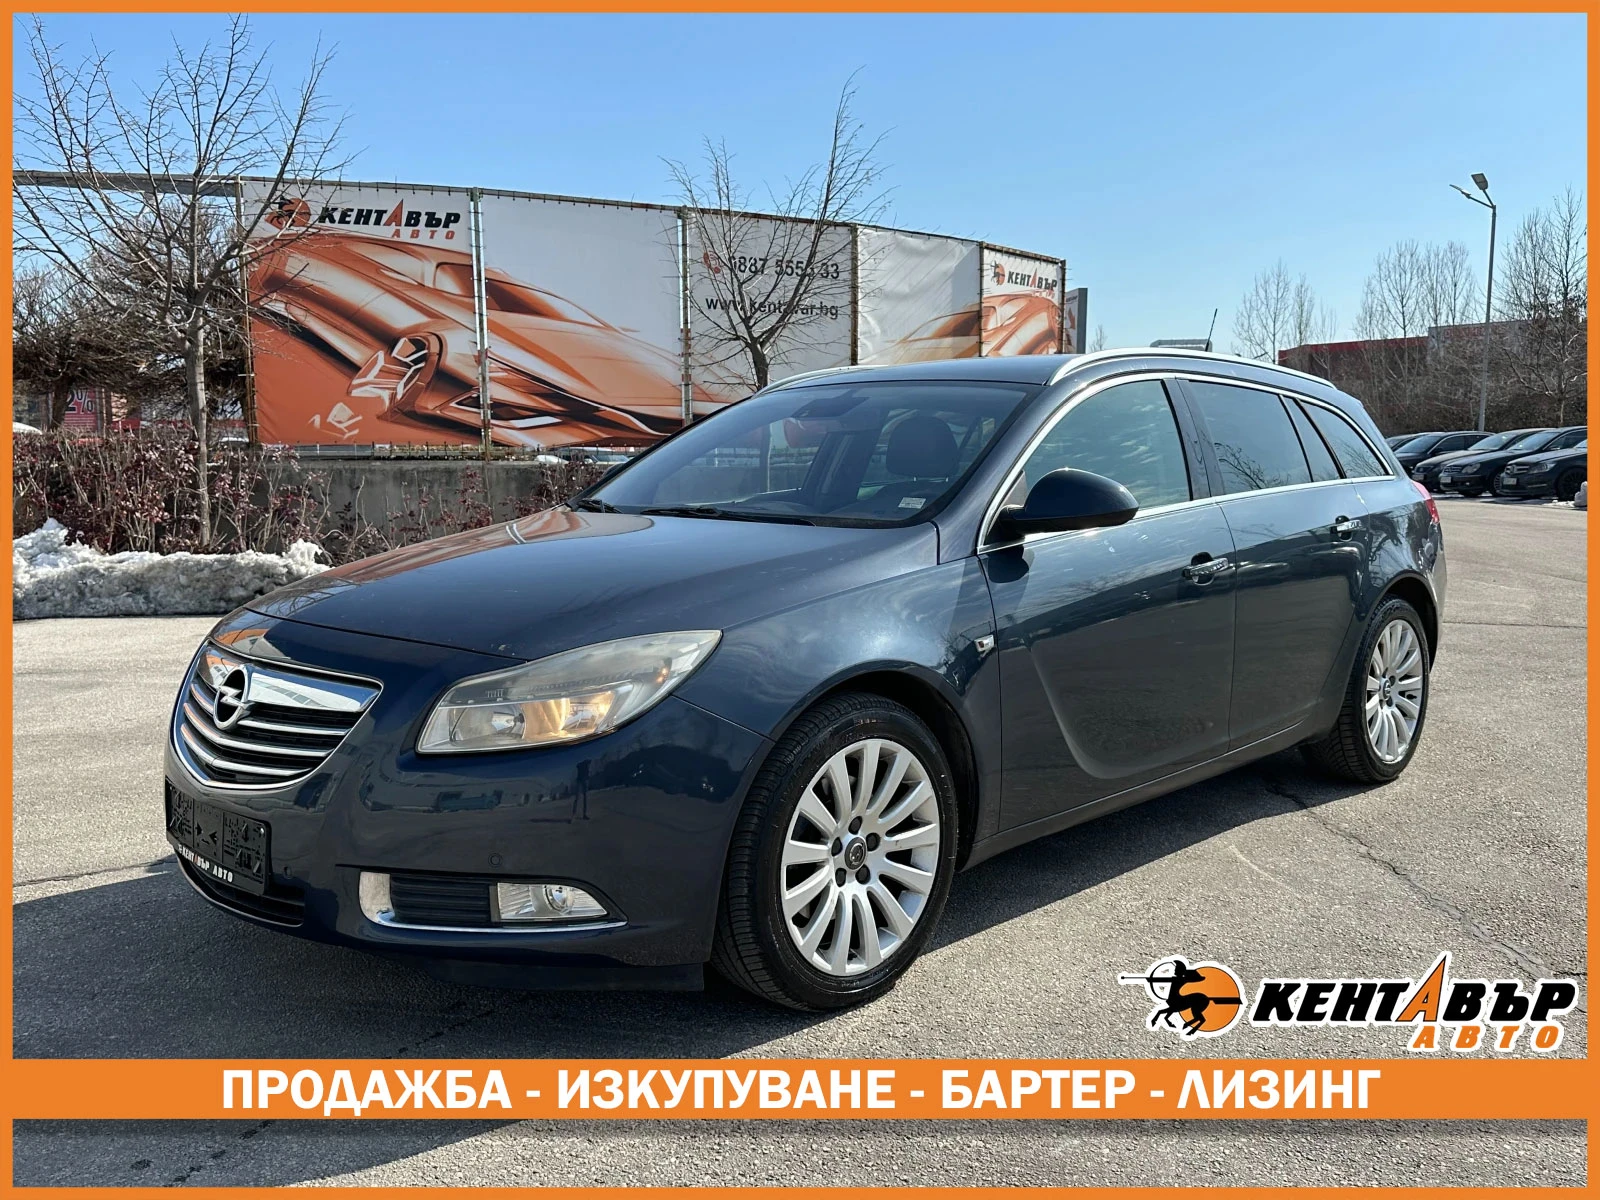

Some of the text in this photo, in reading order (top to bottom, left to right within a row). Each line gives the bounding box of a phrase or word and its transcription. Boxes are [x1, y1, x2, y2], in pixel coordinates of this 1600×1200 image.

[318, 199, 461, 229] КЕНТАВЪР
[391, 228, 456, 240] АВТО
[1007, 267, 1058, 291] КЕНТАВЪР
[706, 298, 839, 320] wwwkentvar.bg
[212, 864, 234, 883] АВТО
